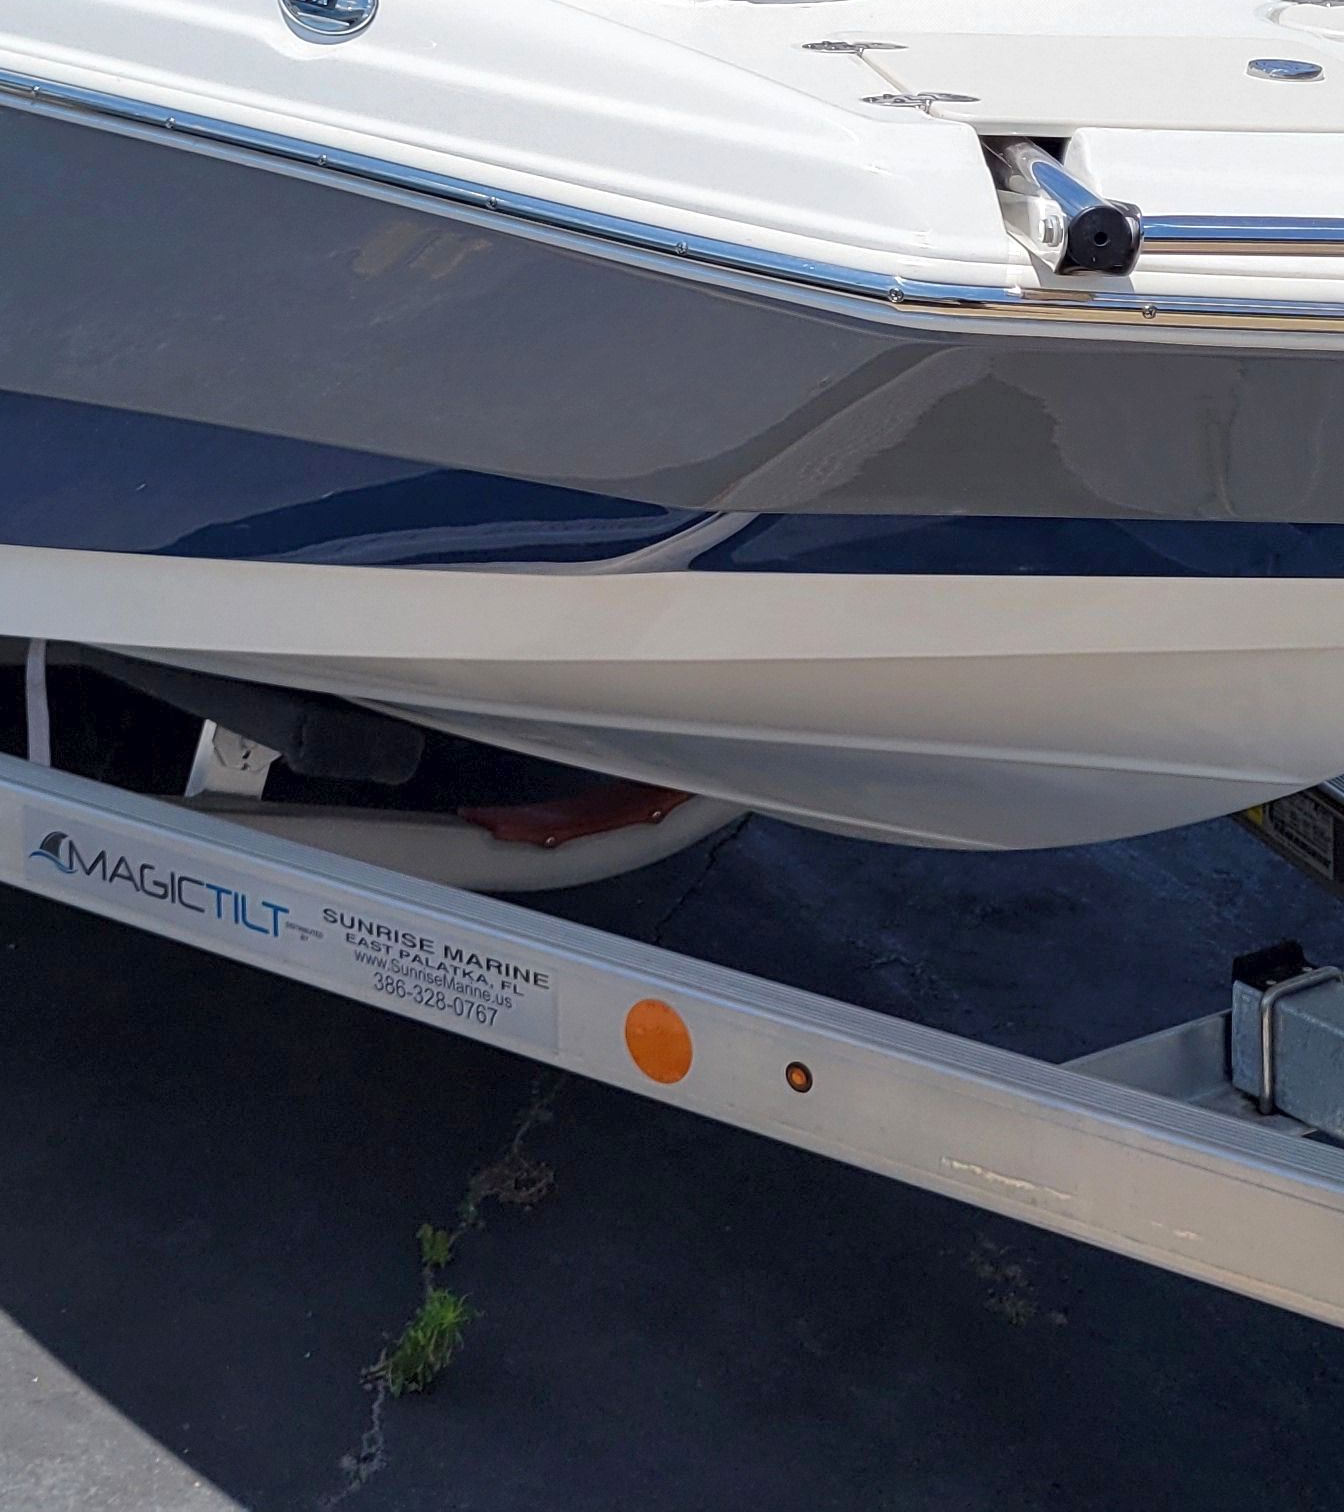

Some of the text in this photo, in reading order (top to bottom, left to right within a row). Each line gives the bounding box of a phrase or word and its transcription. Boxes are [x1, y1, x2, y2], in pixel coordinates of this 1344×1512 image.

[322, 907, 551, 991] SUNRISE MARINE
[345, 931, 525, 997] EAST PALATKA, FL
[354, 949, 514, 1009] www.SunriseMarine.us
[373, 971, 498, 1027] 386-328-0767
